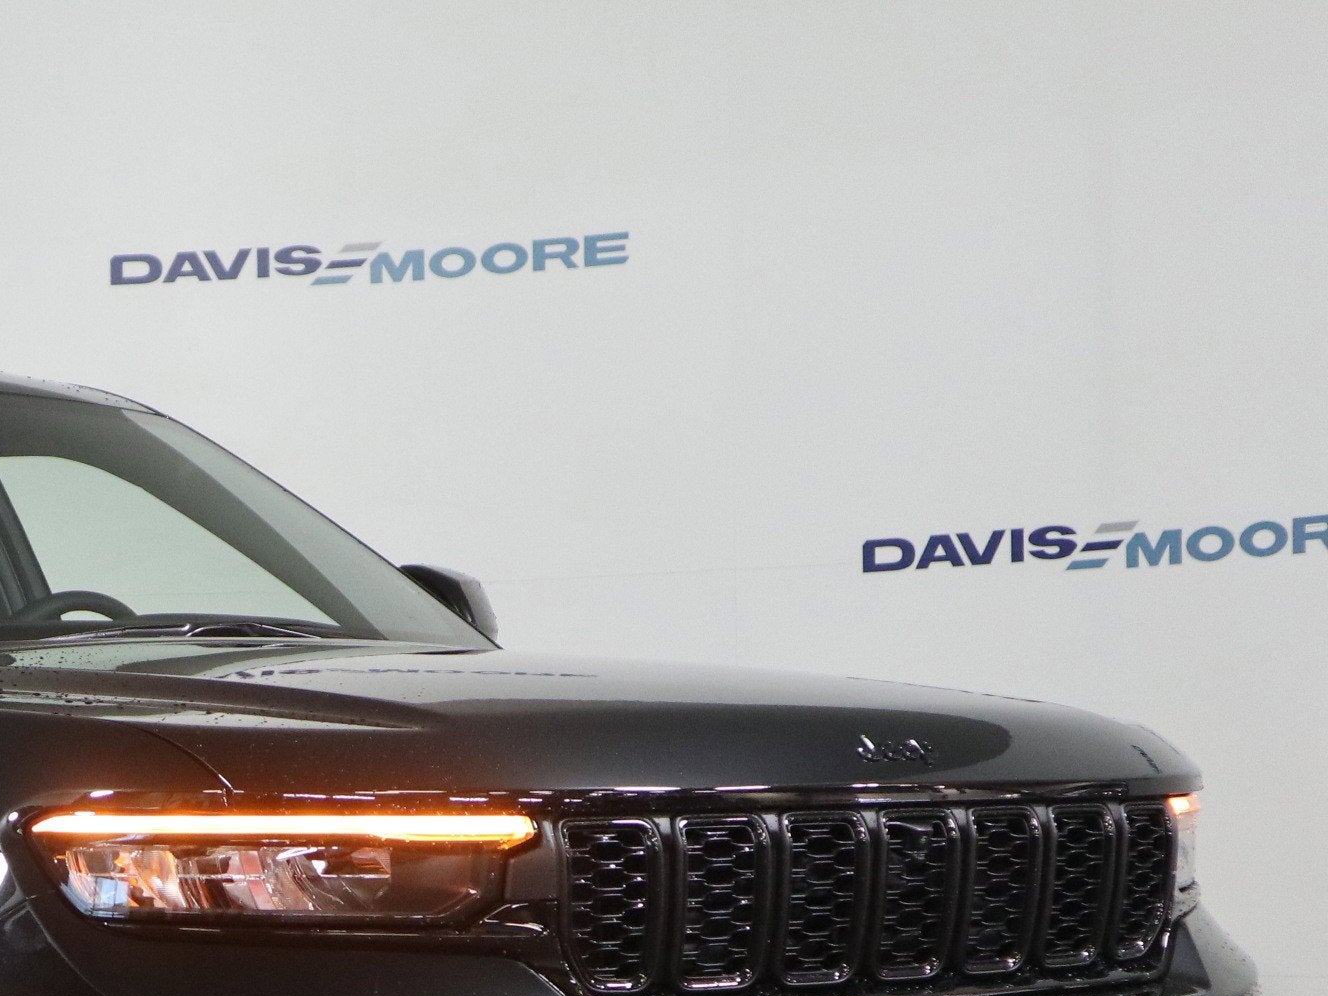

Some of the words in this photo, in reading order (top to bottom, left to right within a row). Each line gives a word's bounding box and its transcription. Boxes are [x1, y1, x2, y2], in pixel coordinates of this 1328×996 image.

[109, 245, 323, 286] DAVIS
[369, 231, 630, 285] MOORE
[861, 524, 1078, 574] DAVIS
